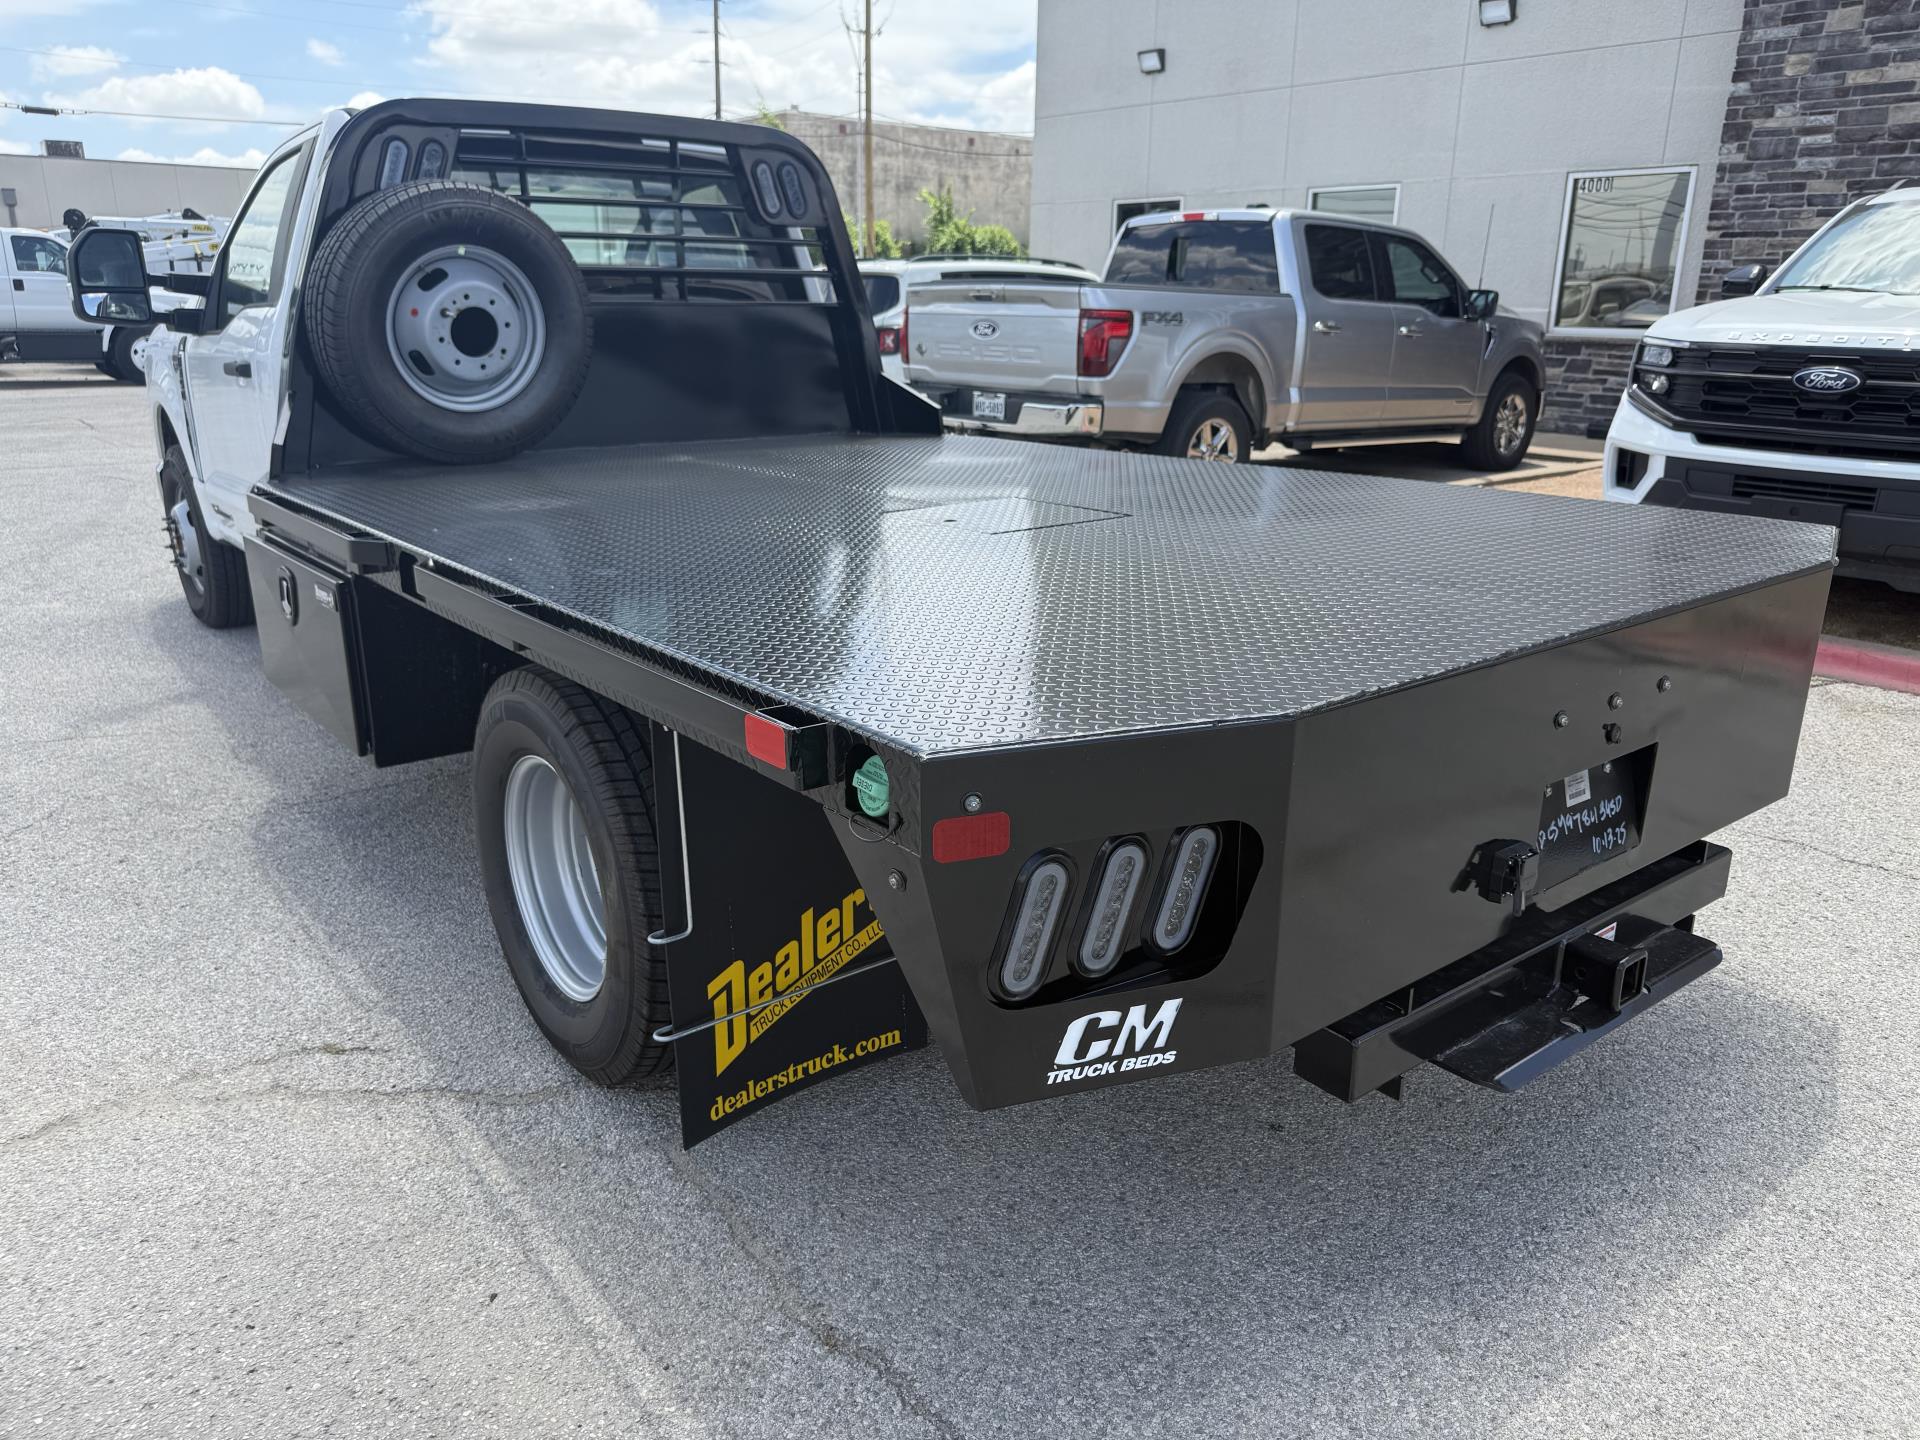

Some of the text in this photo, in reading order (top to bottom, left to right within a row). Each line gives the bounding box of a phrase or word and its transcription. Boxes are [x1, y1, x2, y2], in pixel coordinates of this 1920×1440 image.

[1141, 311, 1183, 326] FX4
[933, 343, 1041, 363] F-150
[1805, 371, 1848, 390] Ford
[707, 888, 874, 1077] Dealer
[752, 999, 789, 1034] TRUCK
[789, 950, 844, 1003] EQUIPMENT
[845, 938, 867, 957] CO.,
[1054, 997, 1184, 1065] CM
[709, 1028, 903, 1122] dealerstruck.com
[1047, 1050, 1177, 1085] TRUCK BEDS
